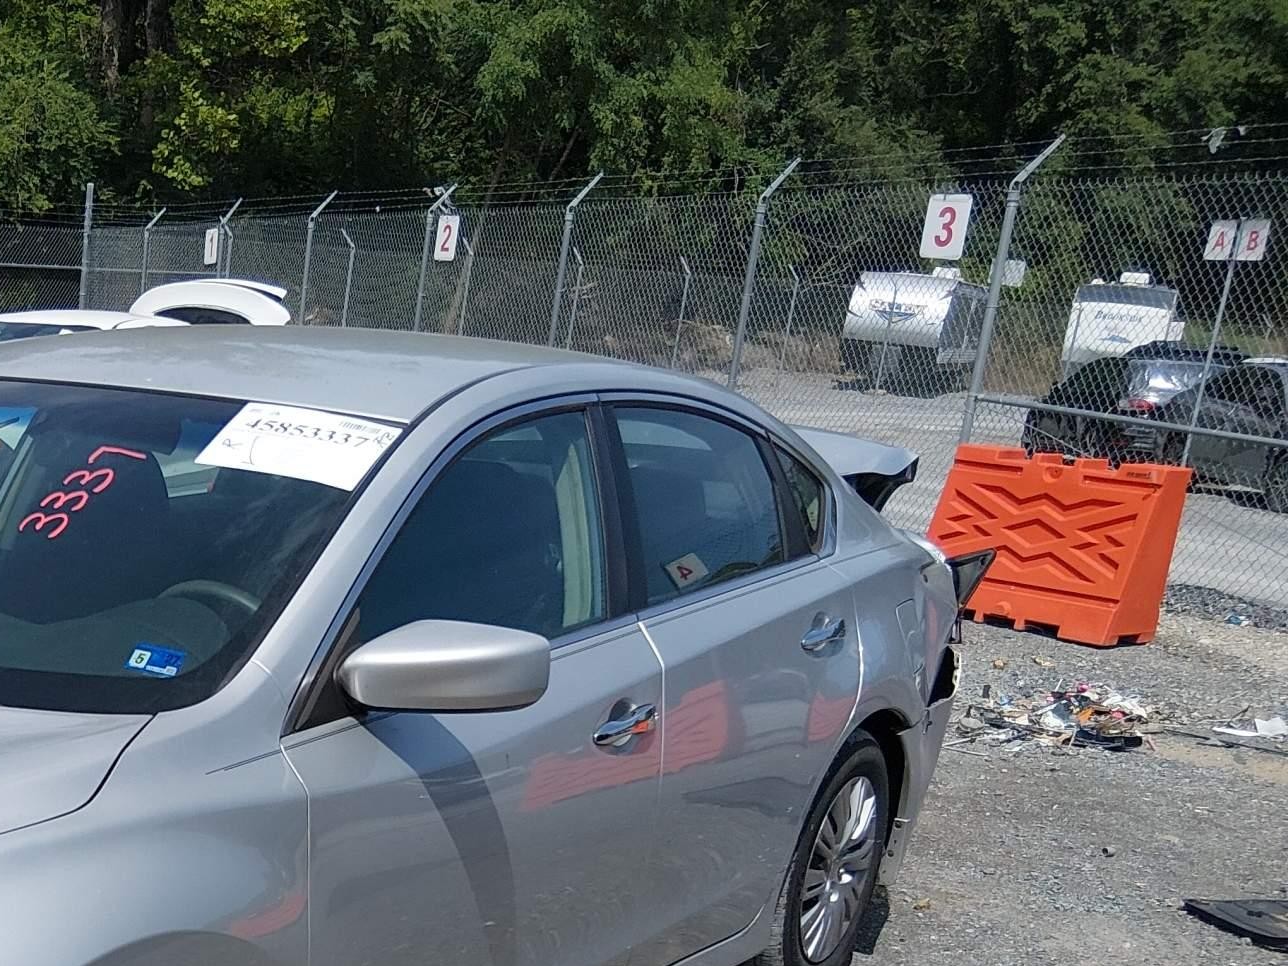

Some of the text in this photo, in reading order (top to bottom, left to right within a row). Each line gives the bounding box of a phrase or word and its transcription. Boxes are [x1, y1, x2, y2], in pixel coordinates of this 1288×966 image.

[440, 224, 452, 252] 2
[934, 206, 957, 248] 3
[1212, 230, 1225, 252] A
[1246, 230, 1260, 251] B
[245, 418, 371, 449] 45853337
[18, 445, 148, 540] 3337
[134, 653, 146, 665] 5
